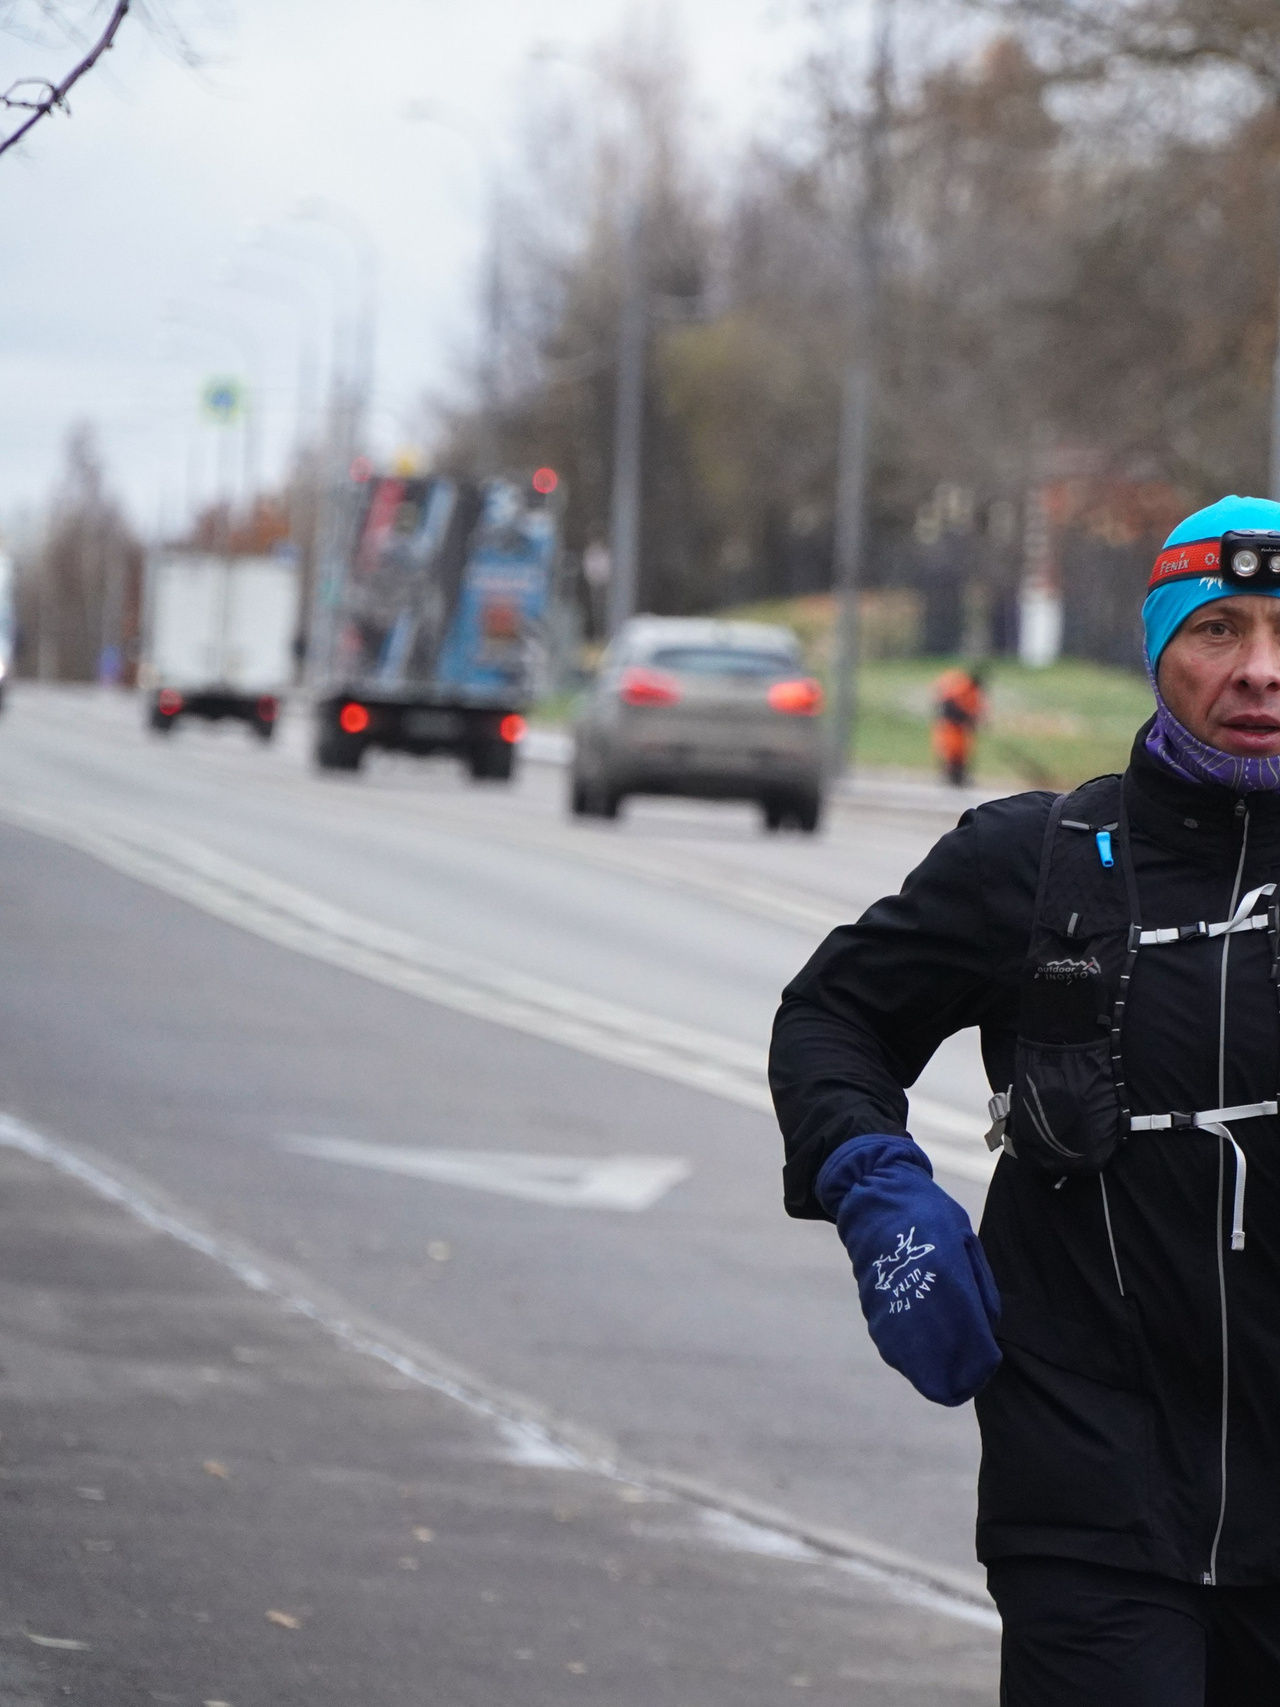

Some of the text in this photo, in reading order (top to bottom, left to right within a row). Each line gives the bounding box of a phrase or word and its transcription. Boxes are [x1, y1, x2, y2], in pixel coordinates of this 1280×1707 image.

[1037, 965, 1075, 973] outdoor
[888, 1271, 937, 1314] MAD FOX
[892, 1268, 922, 1298] ULTRA
